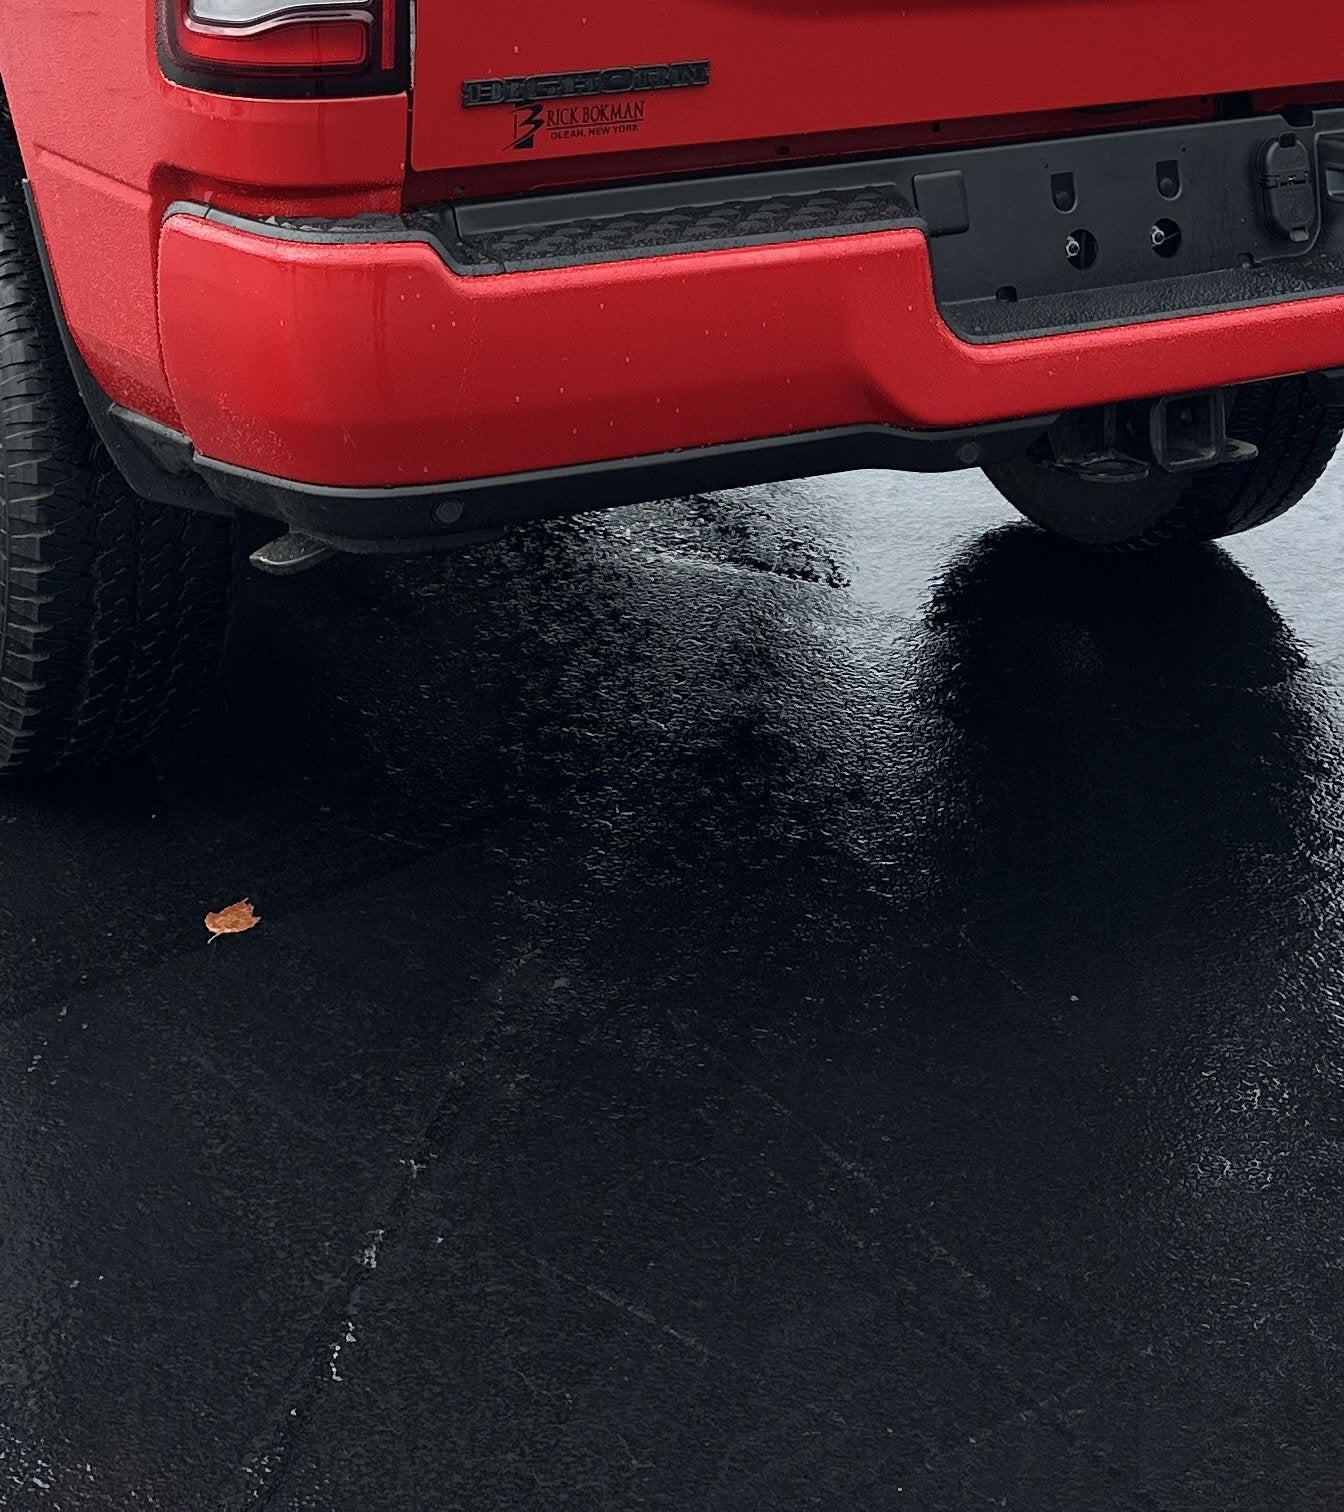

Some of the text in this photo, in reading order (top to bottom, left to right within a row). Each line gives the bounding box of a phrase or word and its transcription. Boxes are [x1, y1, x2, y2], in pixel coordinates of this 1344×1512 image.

[546, 101, 645, 127] RICK BOKMAN
[588, 126, 610, 137] NEW
[613, 123, 640, 134] YORK
